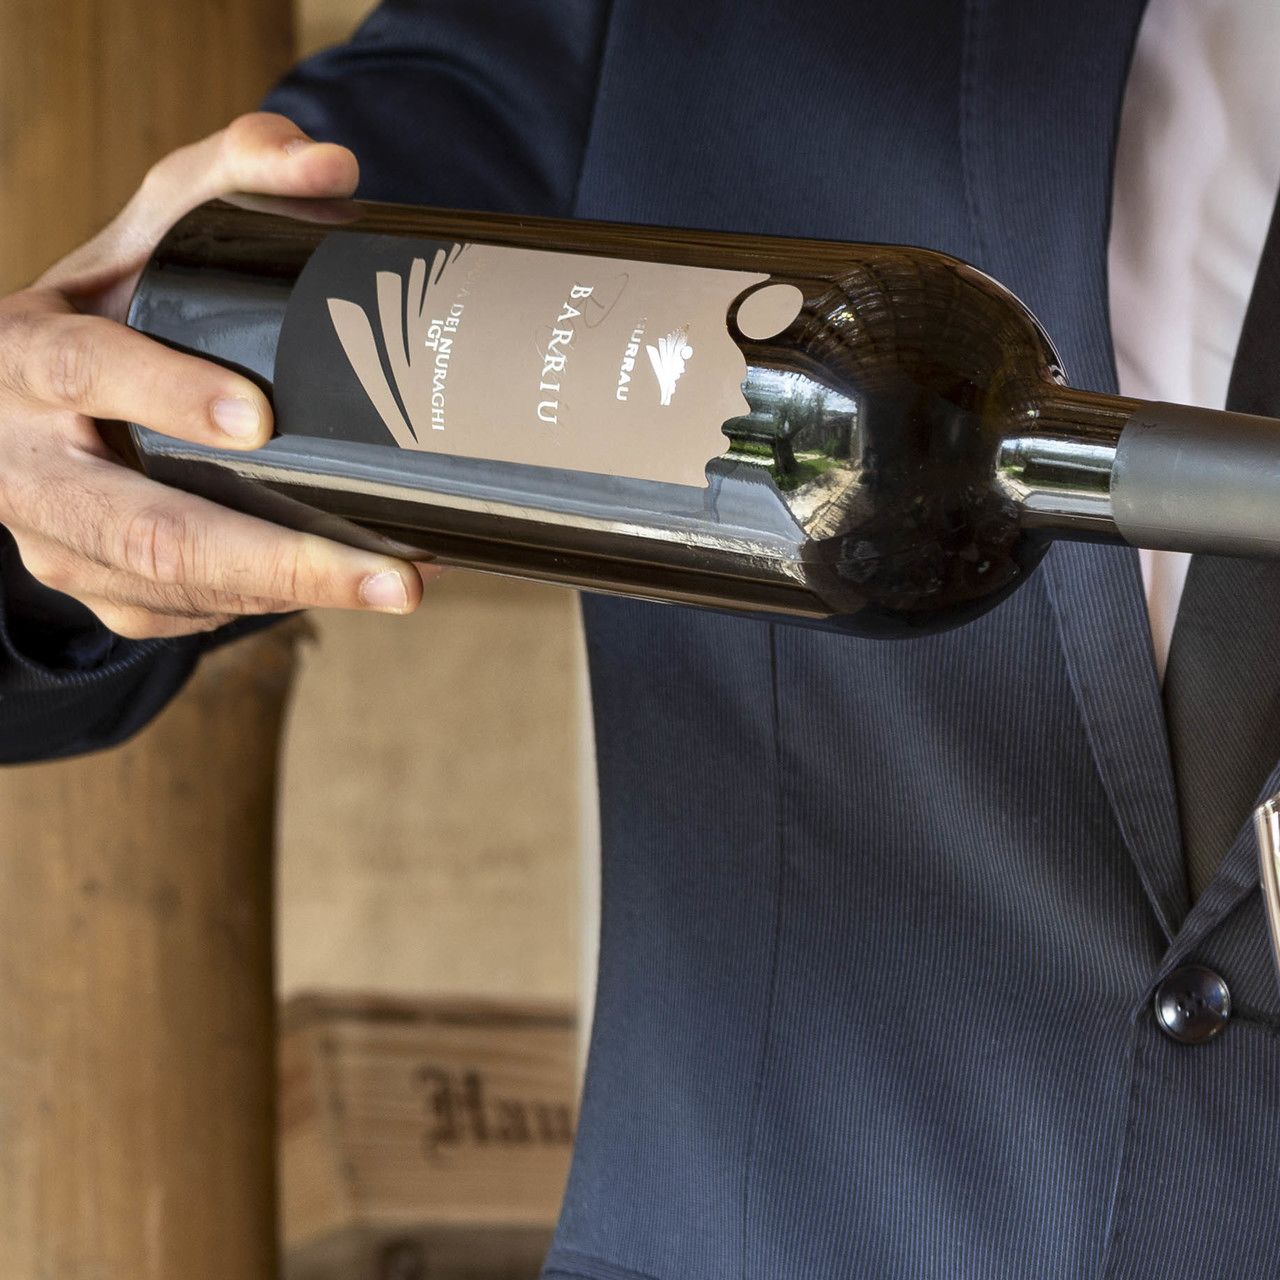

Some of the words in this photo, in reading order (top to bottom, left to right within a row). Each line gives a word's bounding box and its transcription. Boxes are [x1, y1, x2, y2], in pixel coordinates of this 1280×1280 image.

[425, 319, 444, 352] IGT
[537, 284, 594, 425] BARRIU
[431, 337, 453, 431] NURAGHI
